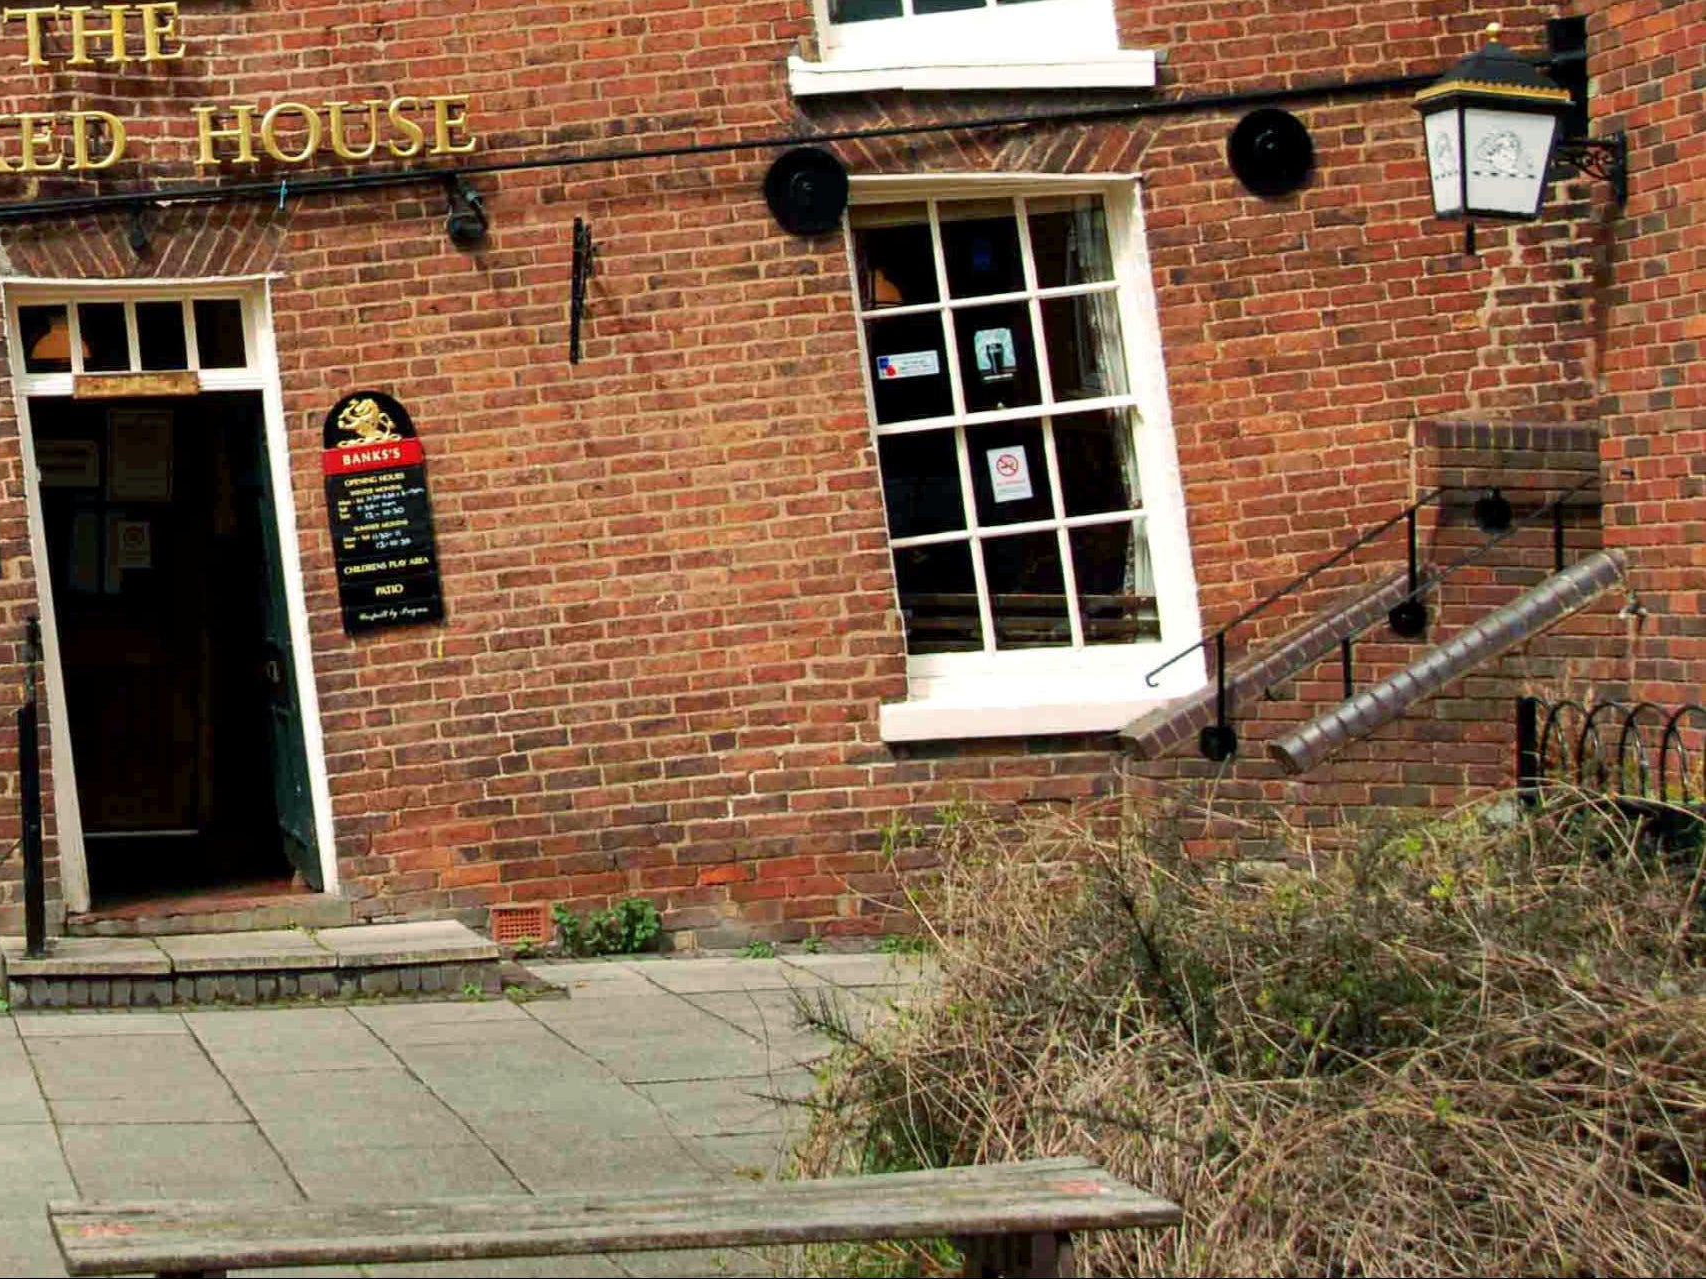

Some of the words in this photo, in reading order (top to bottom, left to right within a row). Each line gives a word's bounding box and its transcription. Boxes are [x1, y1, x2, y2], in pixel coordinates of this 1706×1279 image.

[3, 2, 187, 66] THE
[191, 94, 477, 165] HOUSE
[342, 447, 402, 466] BANKS'S
[388, 559, 407, 569] PLAY
[408, 556, 430, 566] AREA
[375, 583, 405, 597] PATIO
